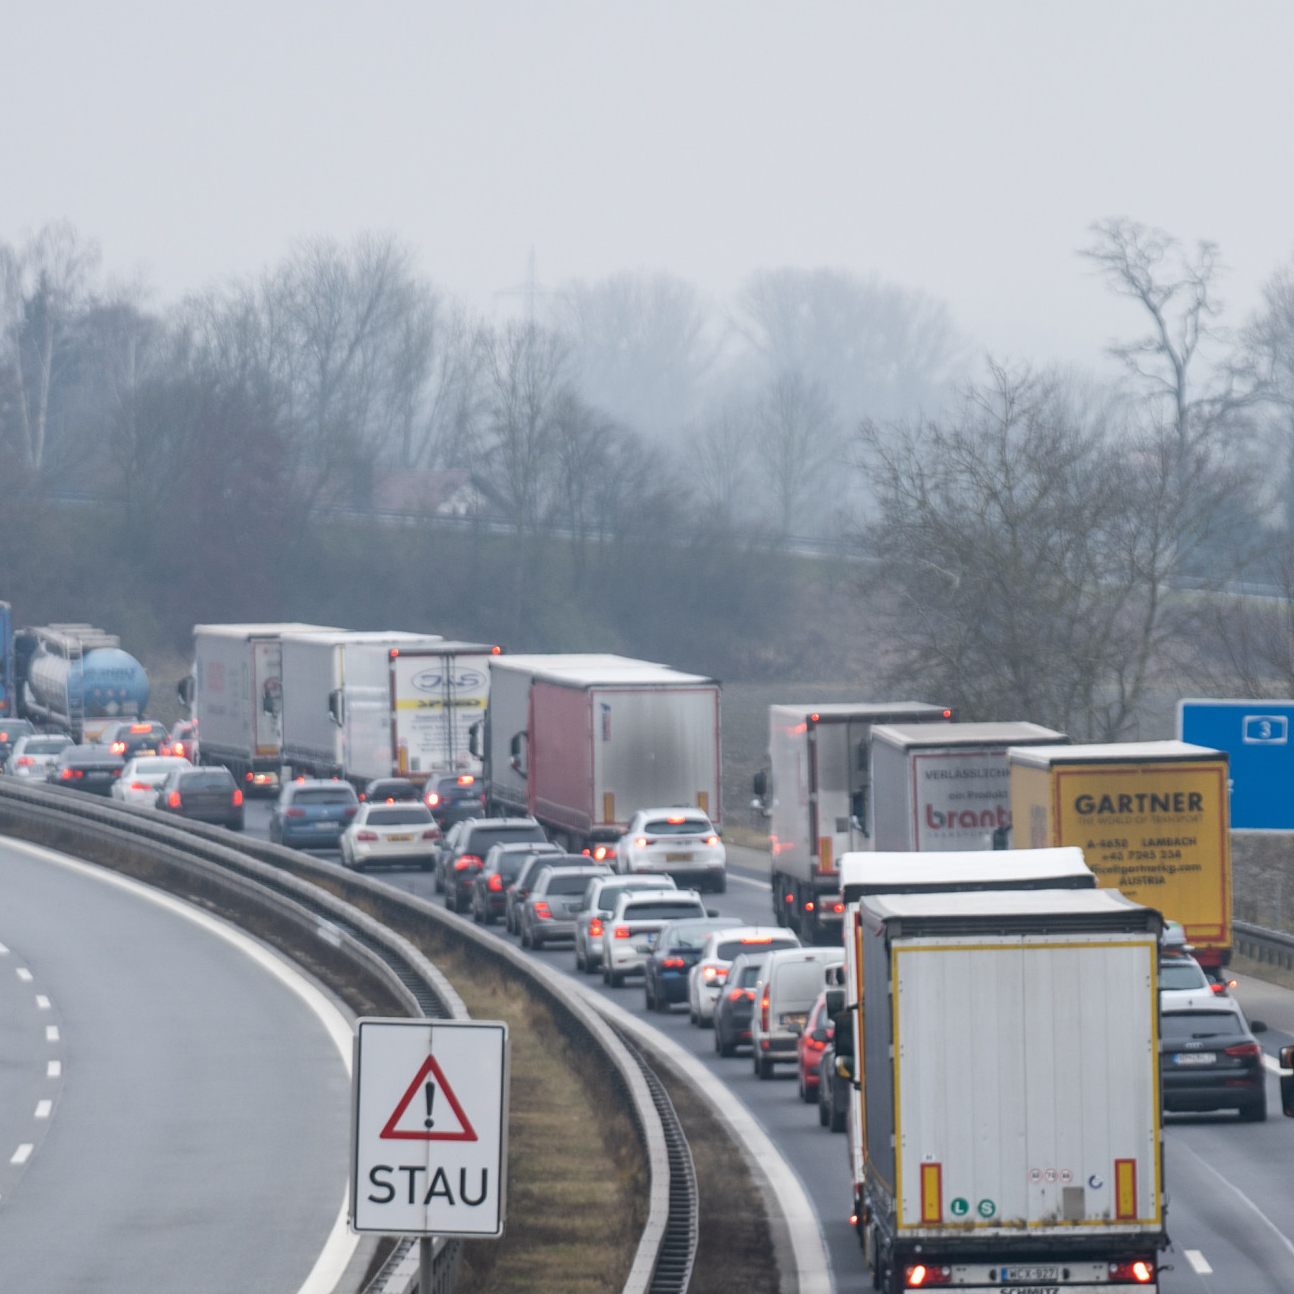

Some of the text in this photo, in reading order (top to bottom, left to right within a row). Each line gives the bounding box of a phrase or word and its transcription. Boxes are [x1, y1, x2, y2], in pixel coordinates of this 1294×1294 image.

[1259, 721, 1272, 739] 3
[1074, 791, 1204, 815] GARTNER
[926, 803, 1012, 830] brant
[367, 1164, 488, 1206] STAU
[954, 1201, 965, 1213] L
[981, 1201, 993, 1214] S
